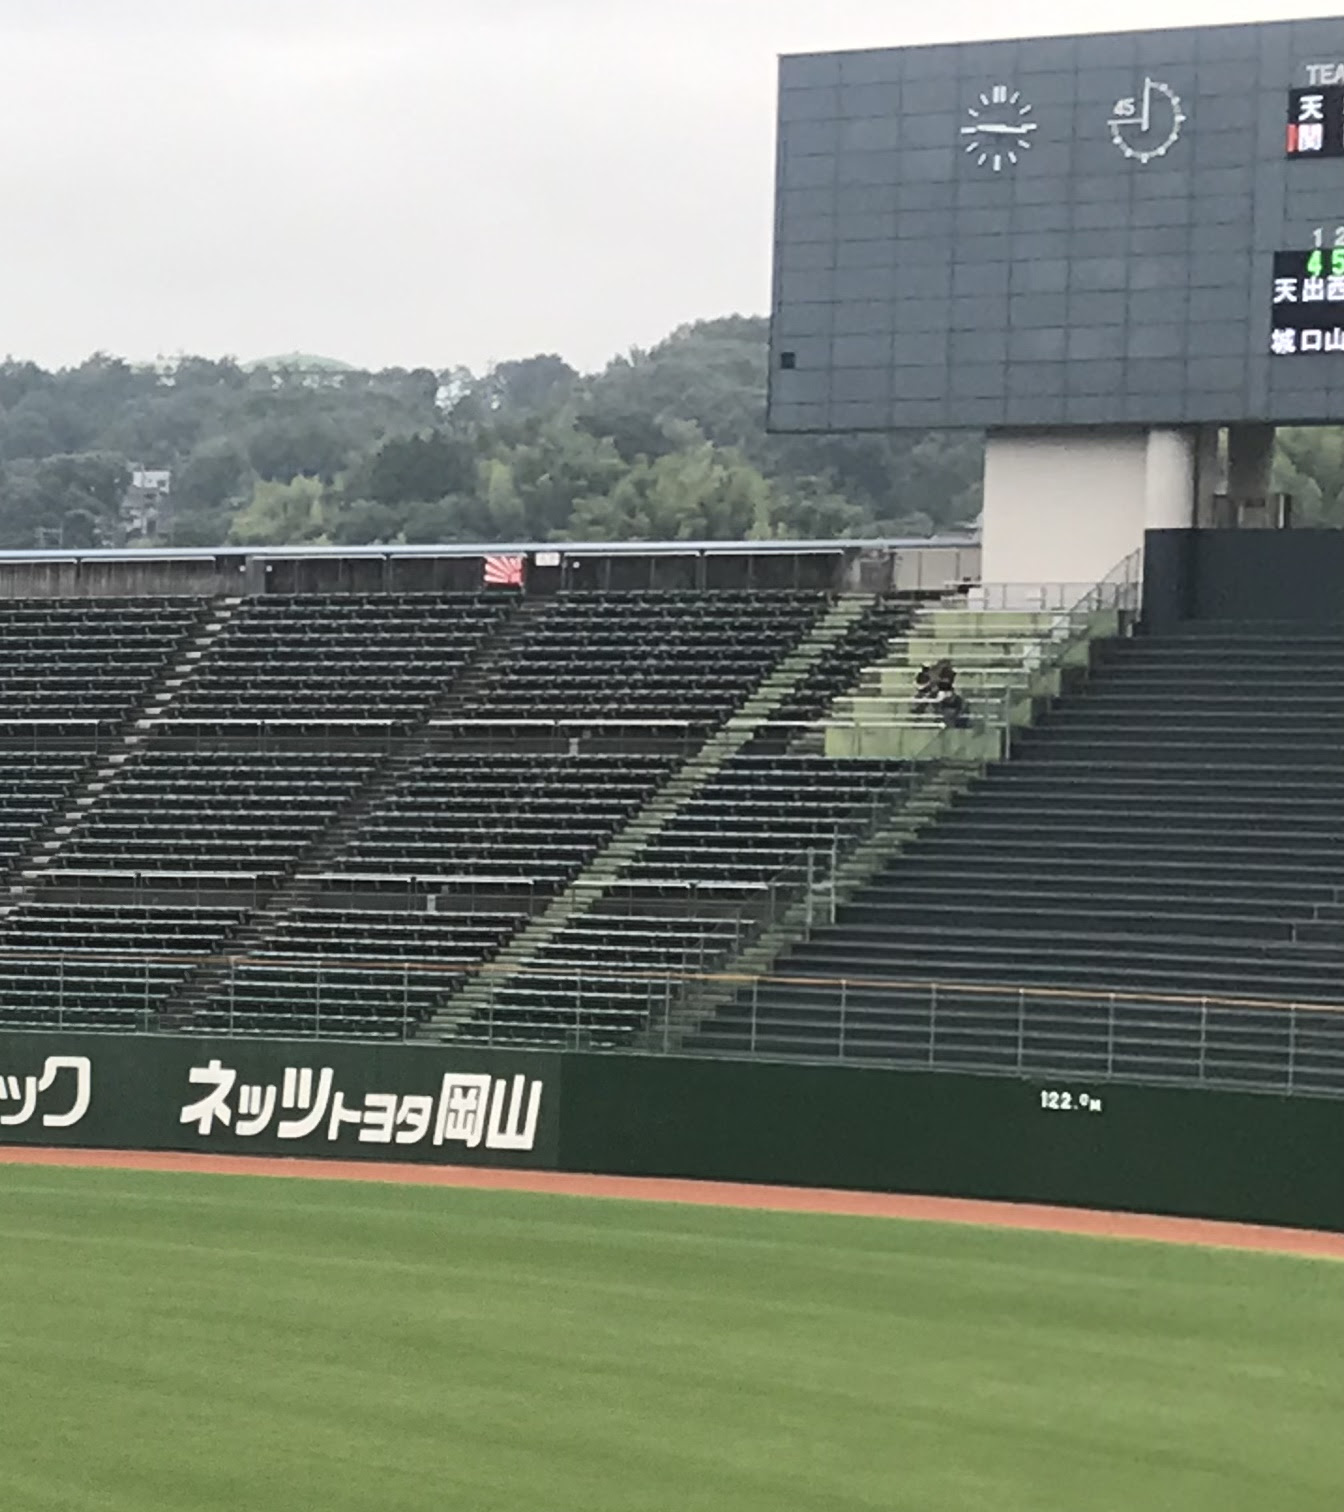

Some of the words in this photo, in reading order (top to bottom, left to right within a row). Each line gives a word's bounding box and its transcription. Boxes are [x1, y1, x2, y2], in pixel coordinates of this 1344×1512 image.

[1113, 97, 1135, 117] 45
[1306, 249, 1322, 277] 4
[179, 1058, 544, 1151] ネッツトヨタ岡山
